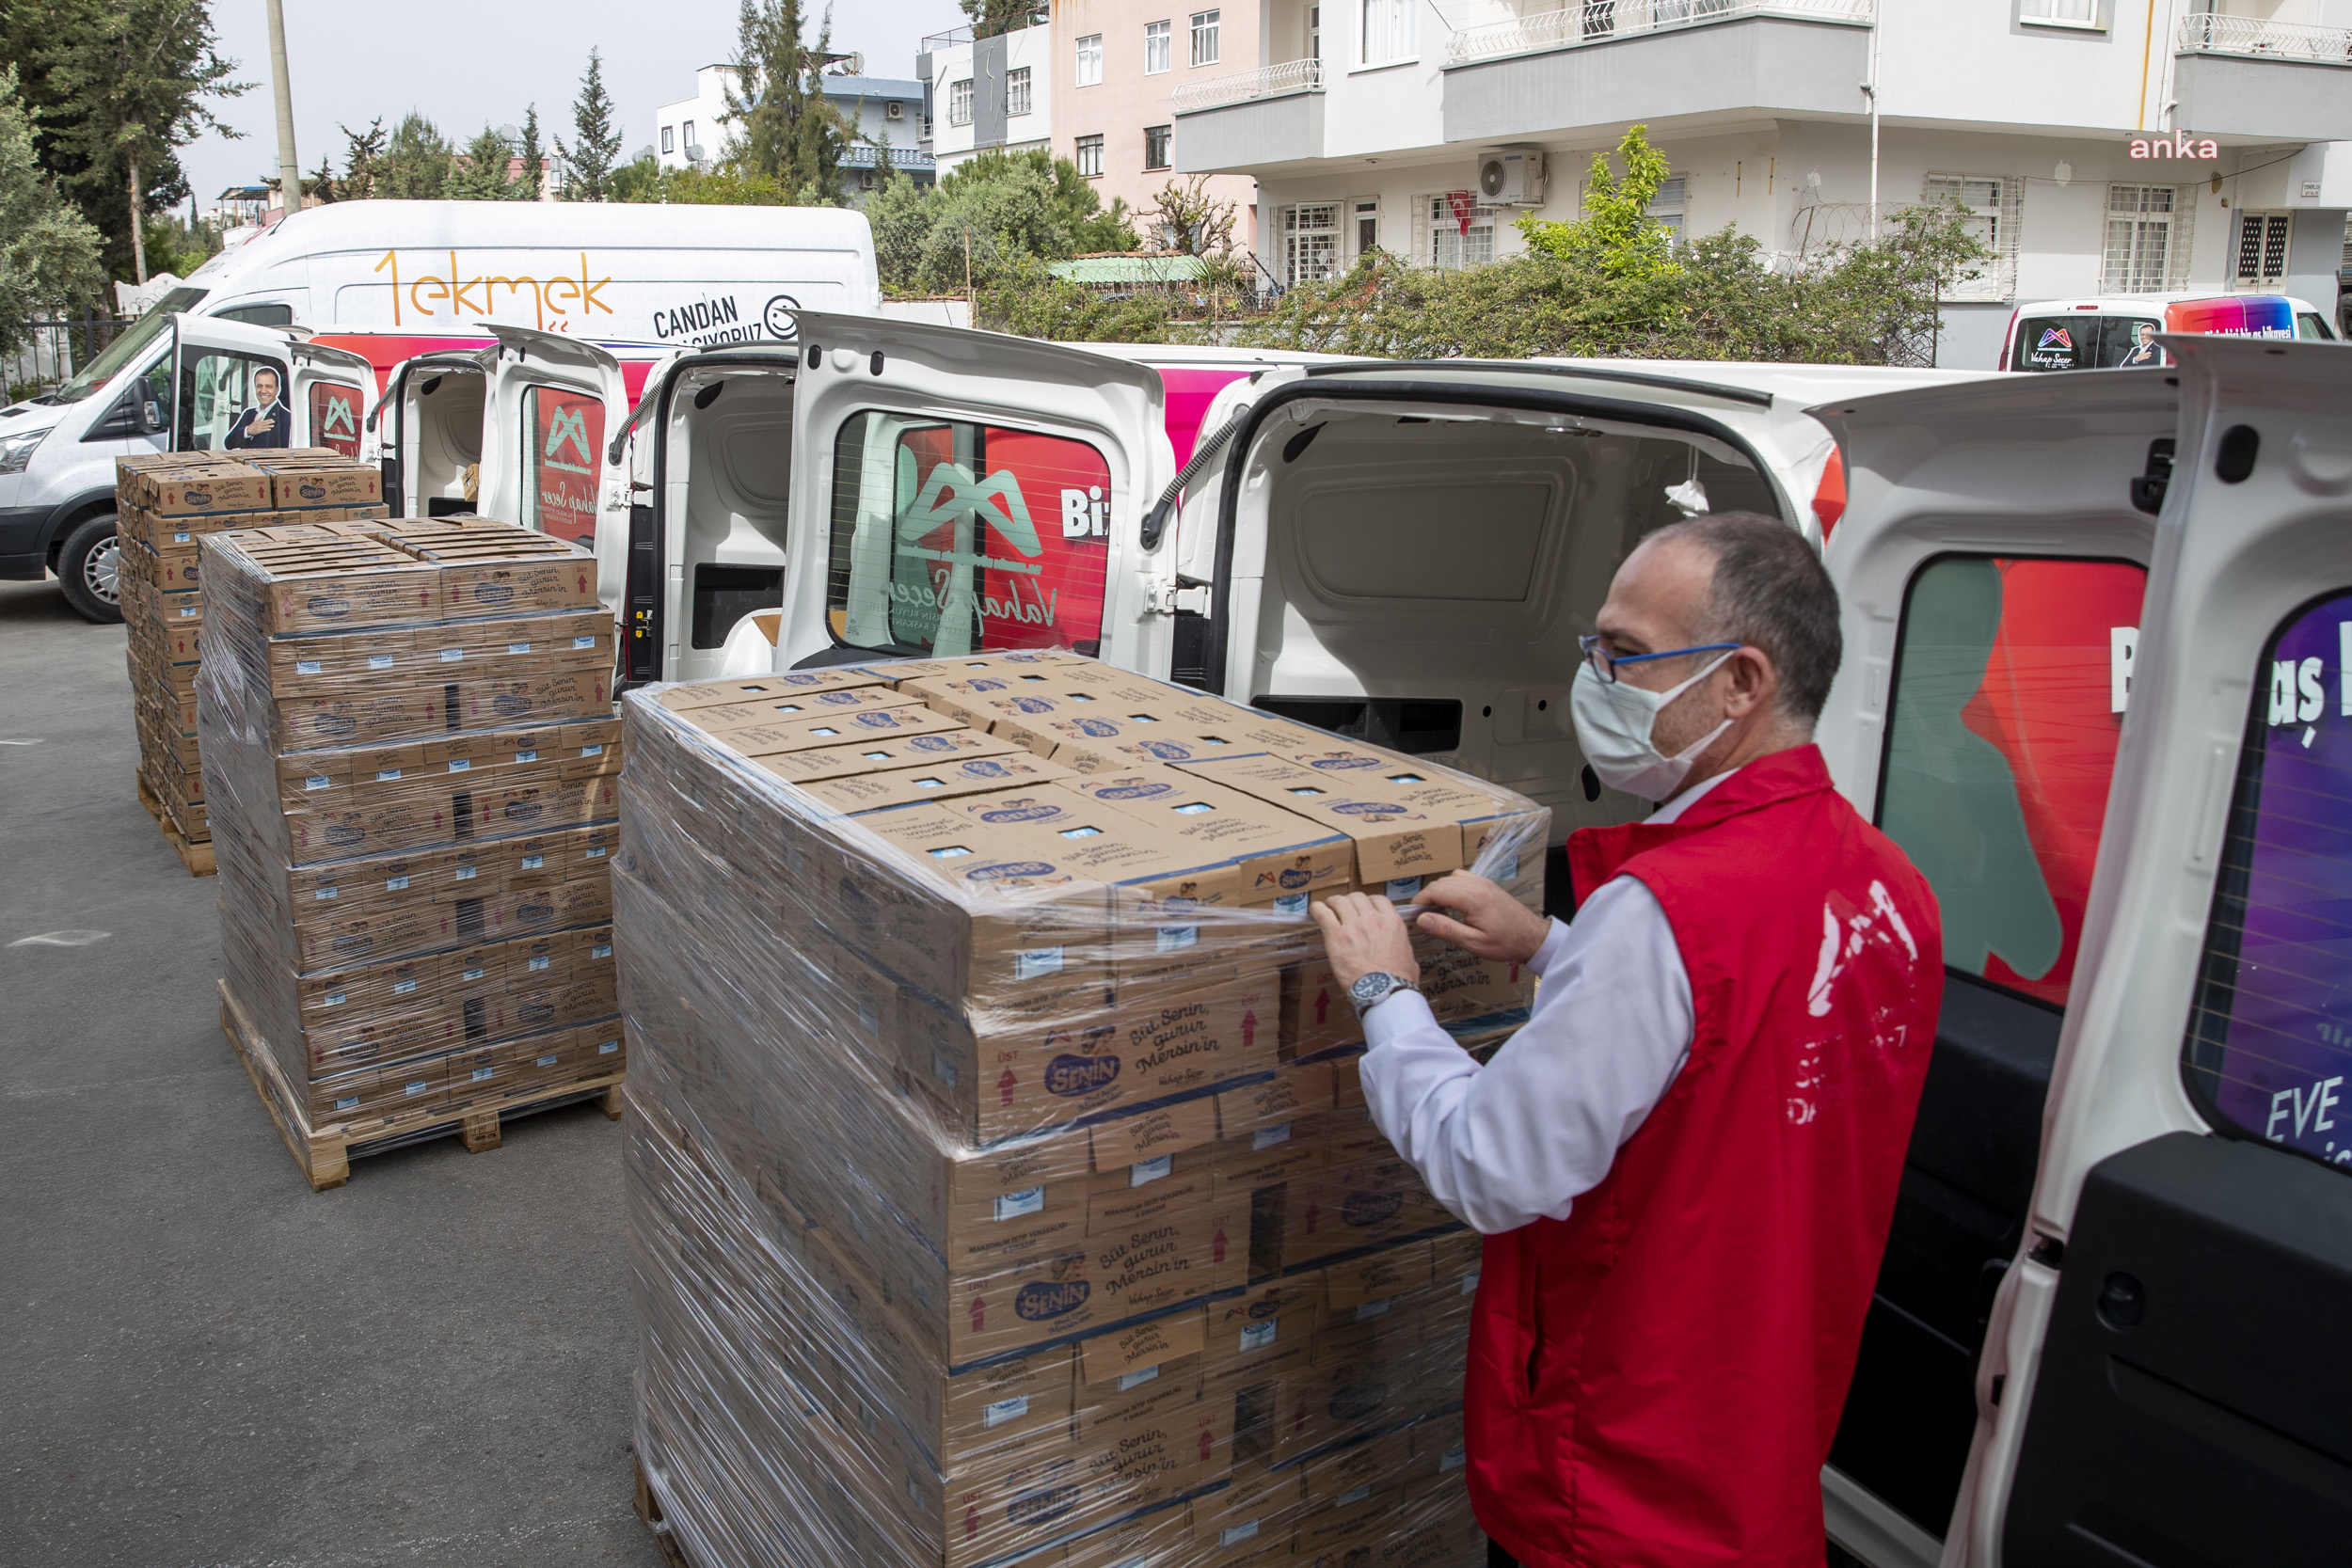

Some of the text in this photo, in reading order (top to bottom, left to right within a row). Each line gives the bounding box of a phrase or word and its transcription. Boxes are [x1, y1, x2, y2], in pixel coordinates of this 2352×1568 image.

[654, 295, 739, 340] CANDAN
[993, 805, 1057, 823] SENİN
[1390, 843, 1403, 854] Süt
[1393, 851, 1433, 870] Mersin'in
[1401, 842, 1425, 856] gurur
[1281, 871, 1311, 886] SENİN
[1241, 993, 1261, 1006] ÜST
[1129, 1001, 1210, 1046] Süt Senin,
[1152, 1020, 1207, 1052] gurur
[998, 1050, 1019, 1063] ÜST
[1136, 1036, 1221, 1075] Mersin'in
[1051, 1059, 1116, 1093] SENİN
[1100, 1225, 1180, 1270] Süt Senin,
[1123, 1242, 1177, 1274] gurur
[1105, 1257, 1190, 1296] Mersin'in
[1022, 1284, 1086, 1318] SENİN
[1132, 1331, 1160, 1350] gurur
[1113, 1443, 1166, 1475] gurur
